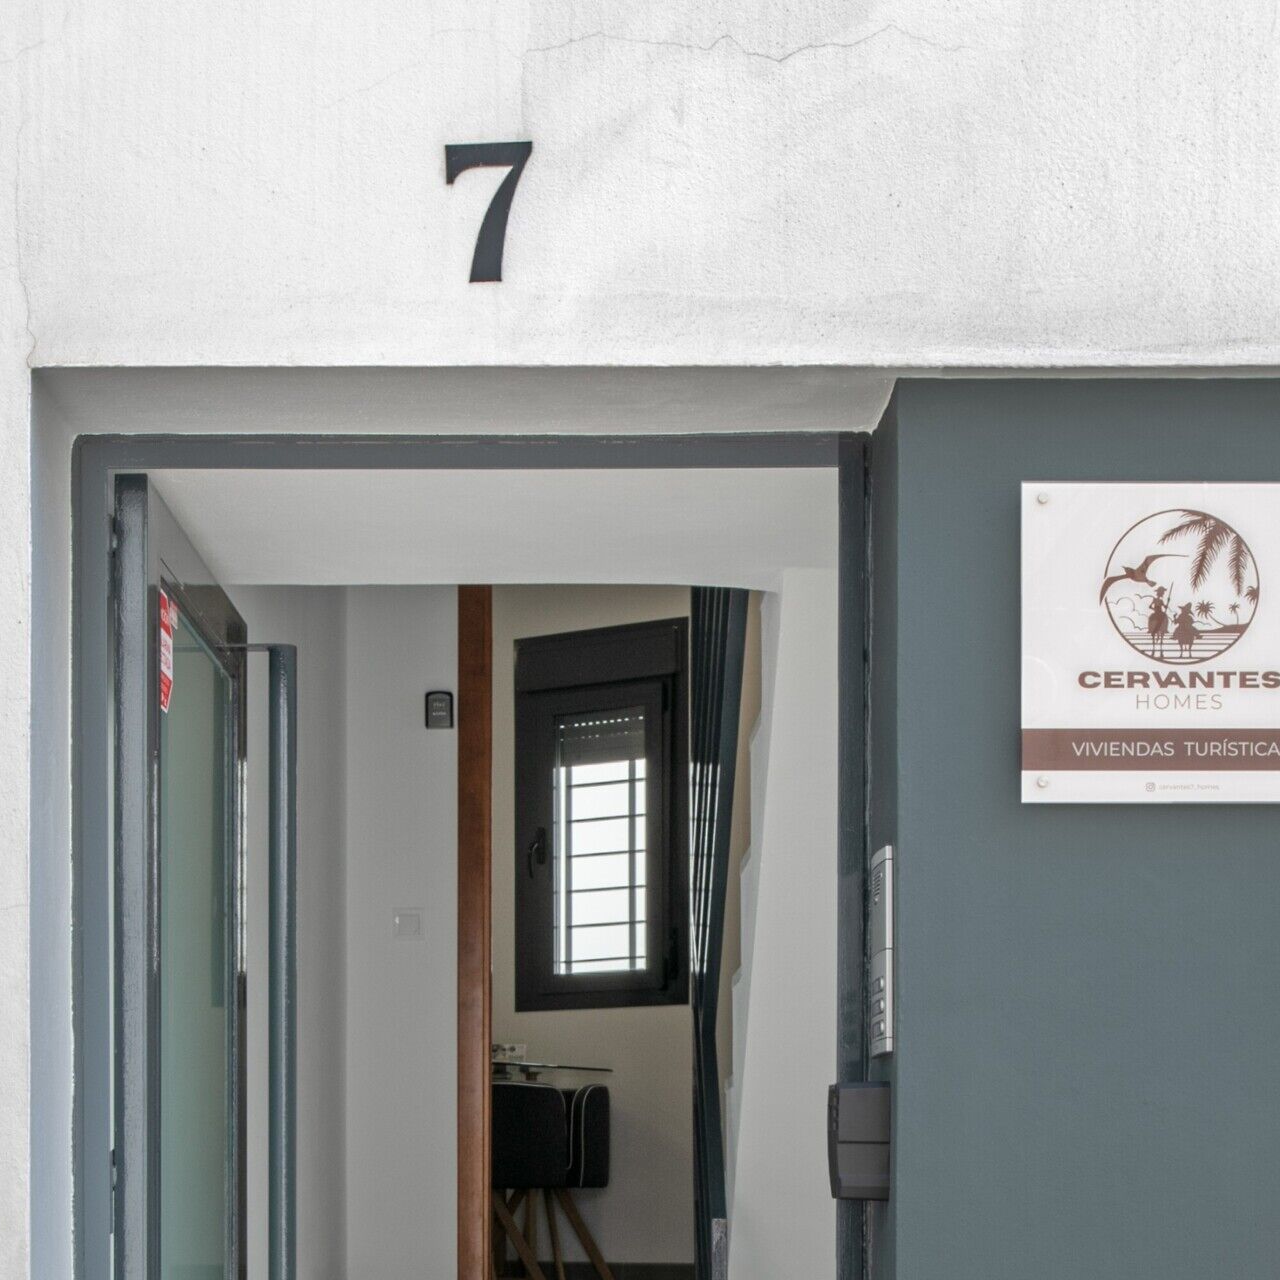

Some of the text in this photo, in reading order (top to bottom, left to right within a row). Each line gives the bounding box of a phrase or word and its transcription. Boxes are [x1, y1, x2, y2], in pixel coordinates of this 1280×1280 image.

[443, 140, 534, 284] 7
[1135, 694, 1222, 710] HOMES
[1072, 741, 1175, 757] VIVIENDAS
